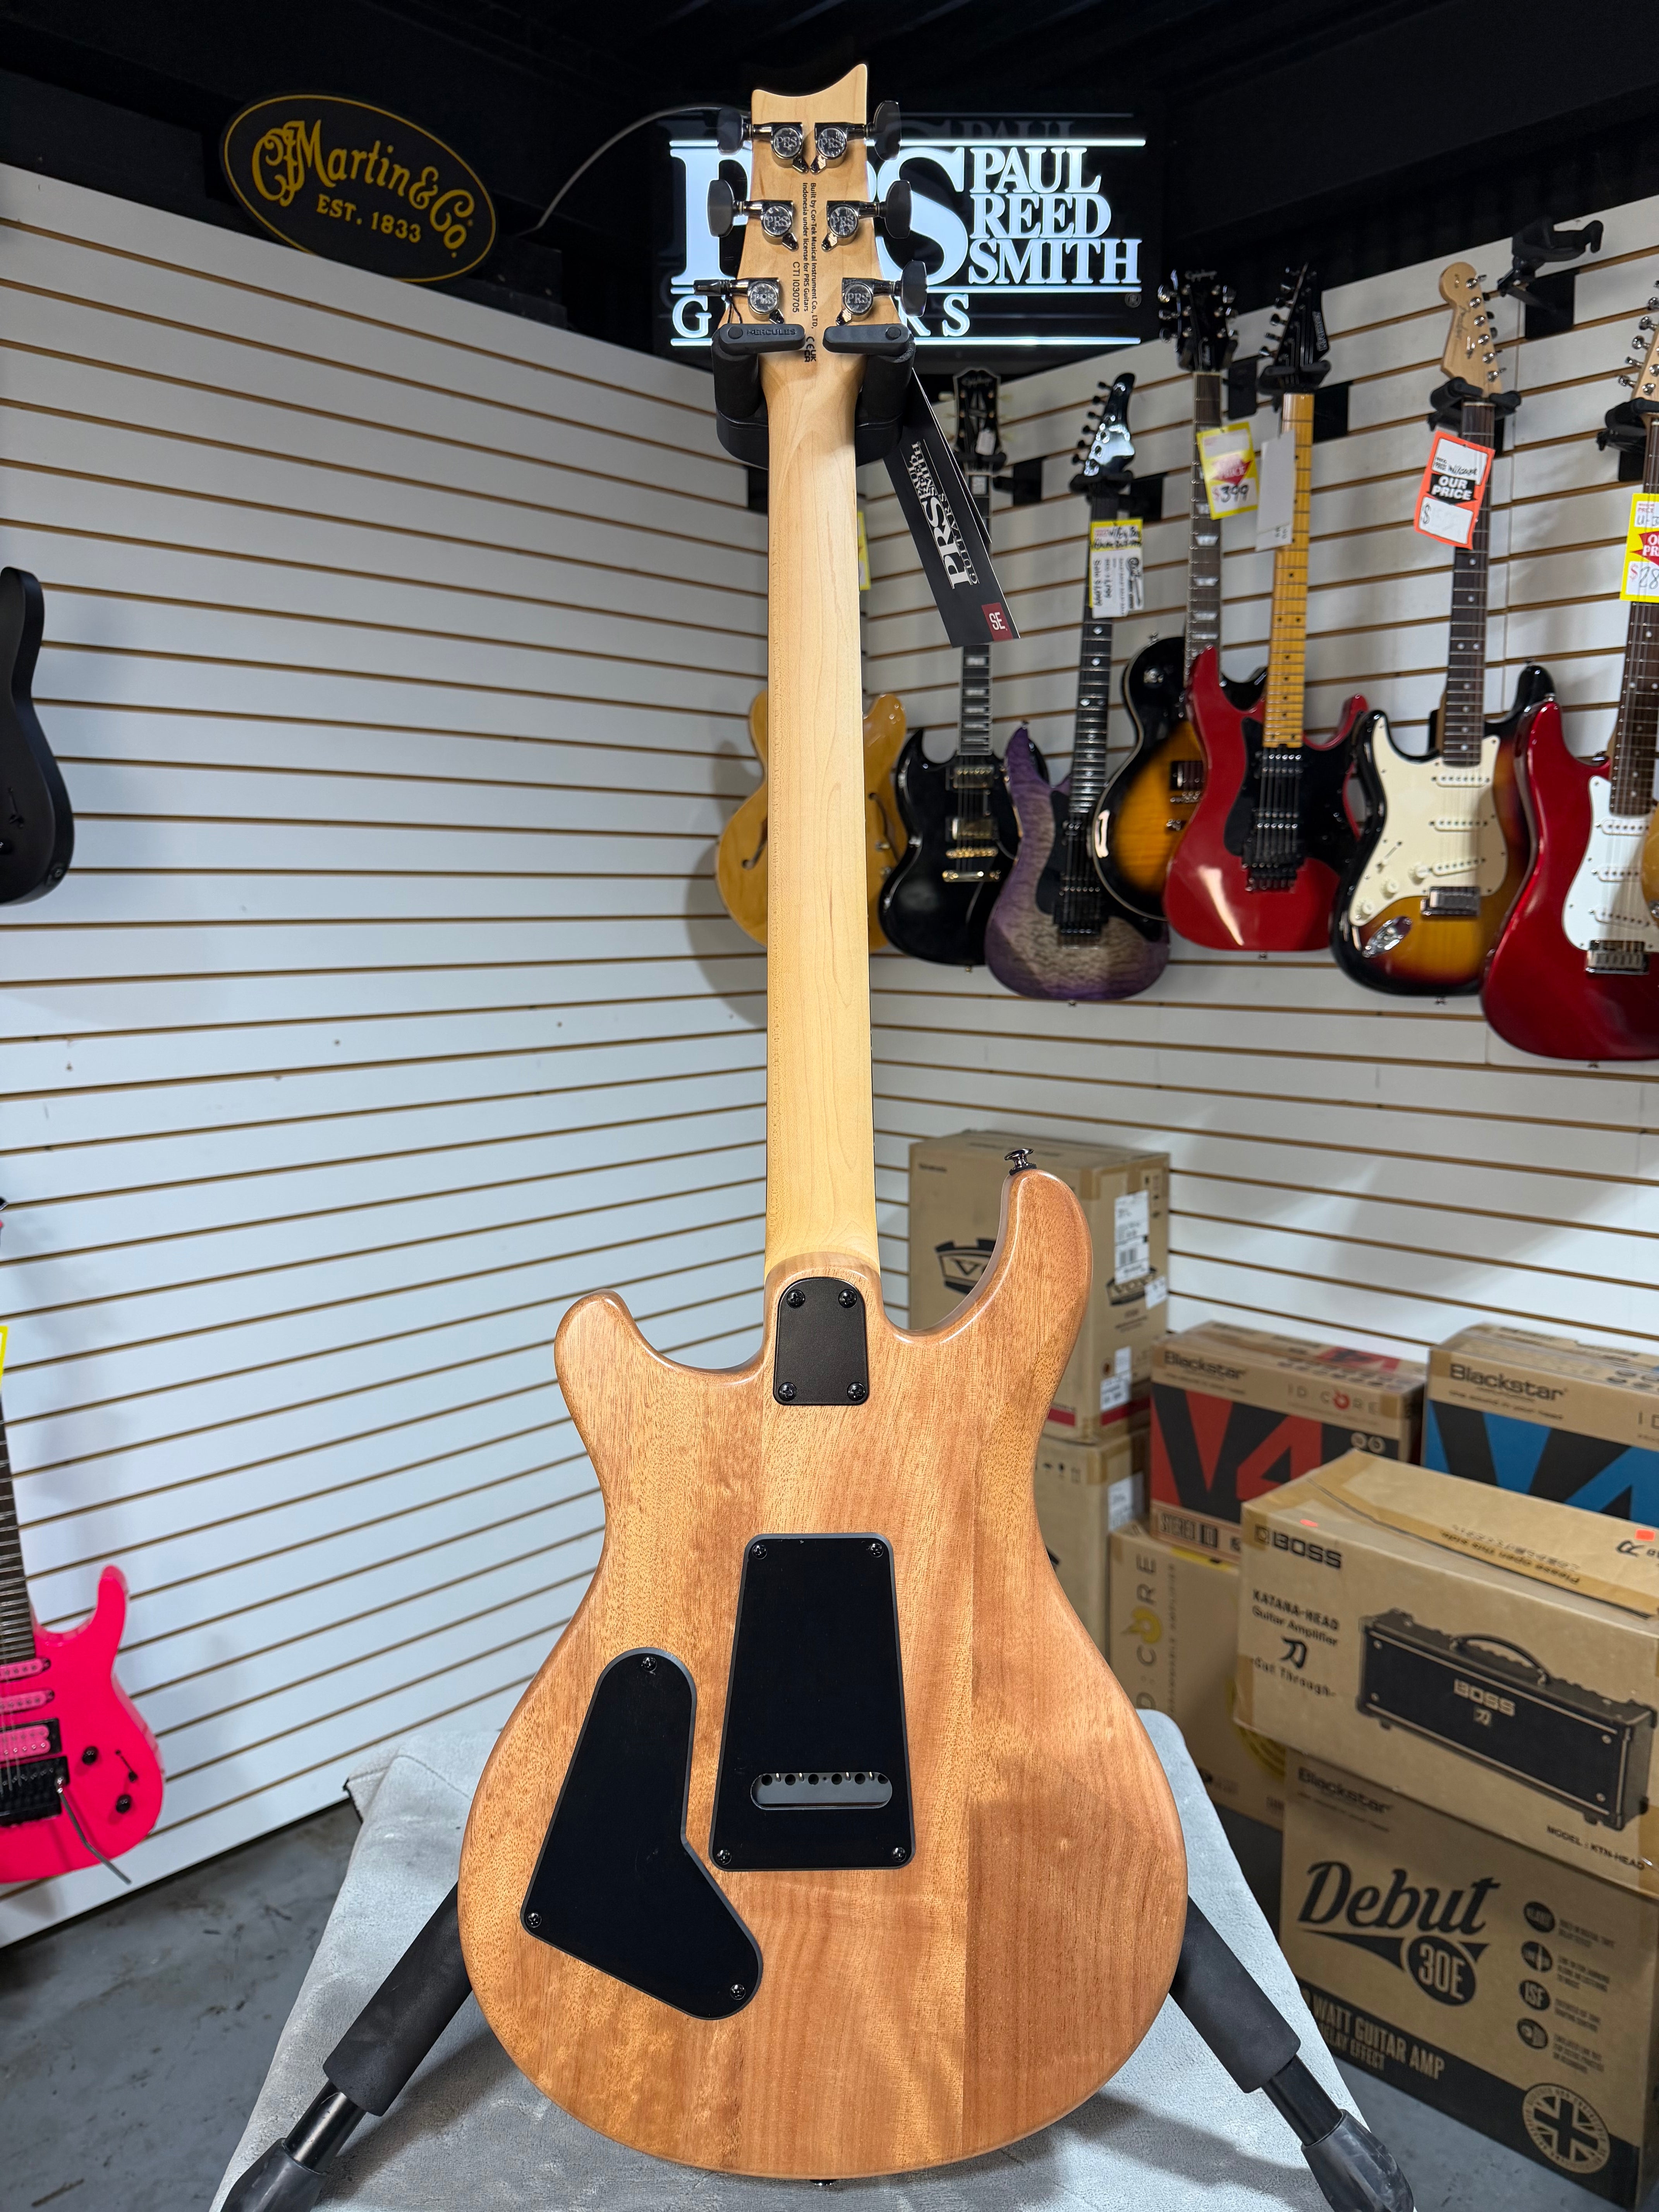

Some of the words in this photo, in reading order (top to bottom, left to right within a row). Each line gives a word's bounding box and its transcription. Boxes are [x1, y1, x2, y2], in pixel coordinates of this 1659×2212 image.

[775, 136, 797, 148] PRS
[820, 137, 842, 148] PRS
[969, 147, 1102, 193] PAUL
[316, 194, 362, 225] EST.
[371, 211, 422, 244] 1833
[671, 147, 968, 286] PS
[767, 215, 790, 227] PRS
[810, 200, 817, 208] by
[831, 216, 854, 228] PRS
[969, 194, 1112, 240] REED
[969, 238, 1142, 284] SMITH
[753, 293, 775, 305] PRS
[847, 292, 869, 304] PRS
[747, 328, 797, 337] HERCULES
[908, 460, 926, 500] PAUL
[911, 455, 931, 498] REED
[912, 442, 937, 496] SMITH
[1438, 476, 1468, 489] OUR
[1431, 484, 1473, 500] PRICE
[922, 497, 972, 589] PRS
[939, 493, 978, 584] GUITARS
[989, 612, 1006, 631] SE
[1450, 1363, 1565, 1401] Blackstar
[1273, 1531, 1342, 1569] BOSS
[1252, 1589, 1340, 1632] KATANA-HEAD
[1252, 1606, 1284, 1626] Guitar
[1287, 1621, 1338, 1647] Amplifier
[1454, 1678, 1516, 1717] BOSS
[1297, 1860, 1501, 1936] Debut
[1418, 1943, 1466, 2001] 30E
[1312, 1994, 1352, 2033] WATT
[1355, 2015, 1407, 2064] GUITAR
[1409, 2044, 1446, 2080] AMP
